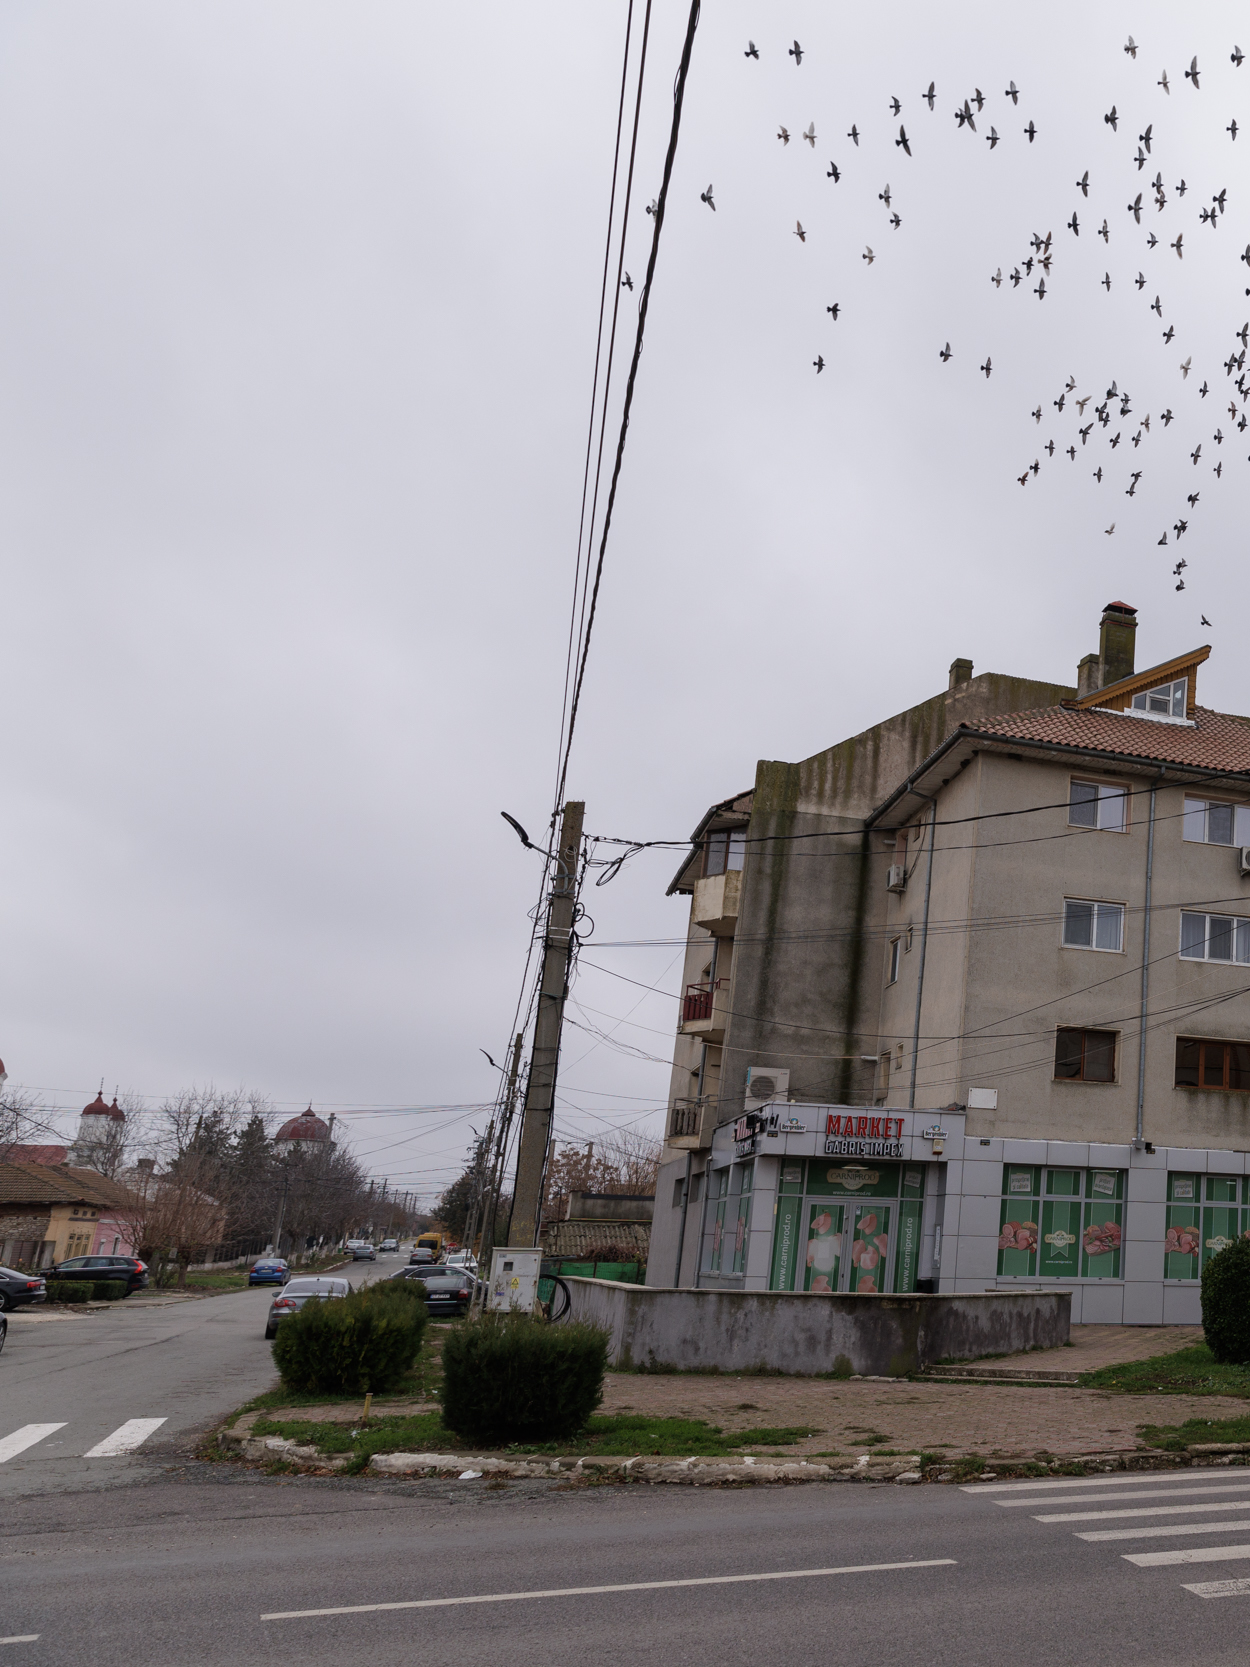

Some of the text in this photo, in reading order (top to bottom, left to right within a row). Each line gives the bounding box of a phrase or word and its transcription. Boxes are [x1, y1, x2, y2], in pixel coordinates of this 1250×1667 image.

[826, 1114, 905, 1138] MARKET
[825, 1139, 905, 1157] GABRIS IMPEX
[830, 1172, 876, 1181] CARNIPROD
[778, 1214, 792, 1290] www.carniprod.ro
[902, 1217, 913, 1292] www.carniprod.ro
